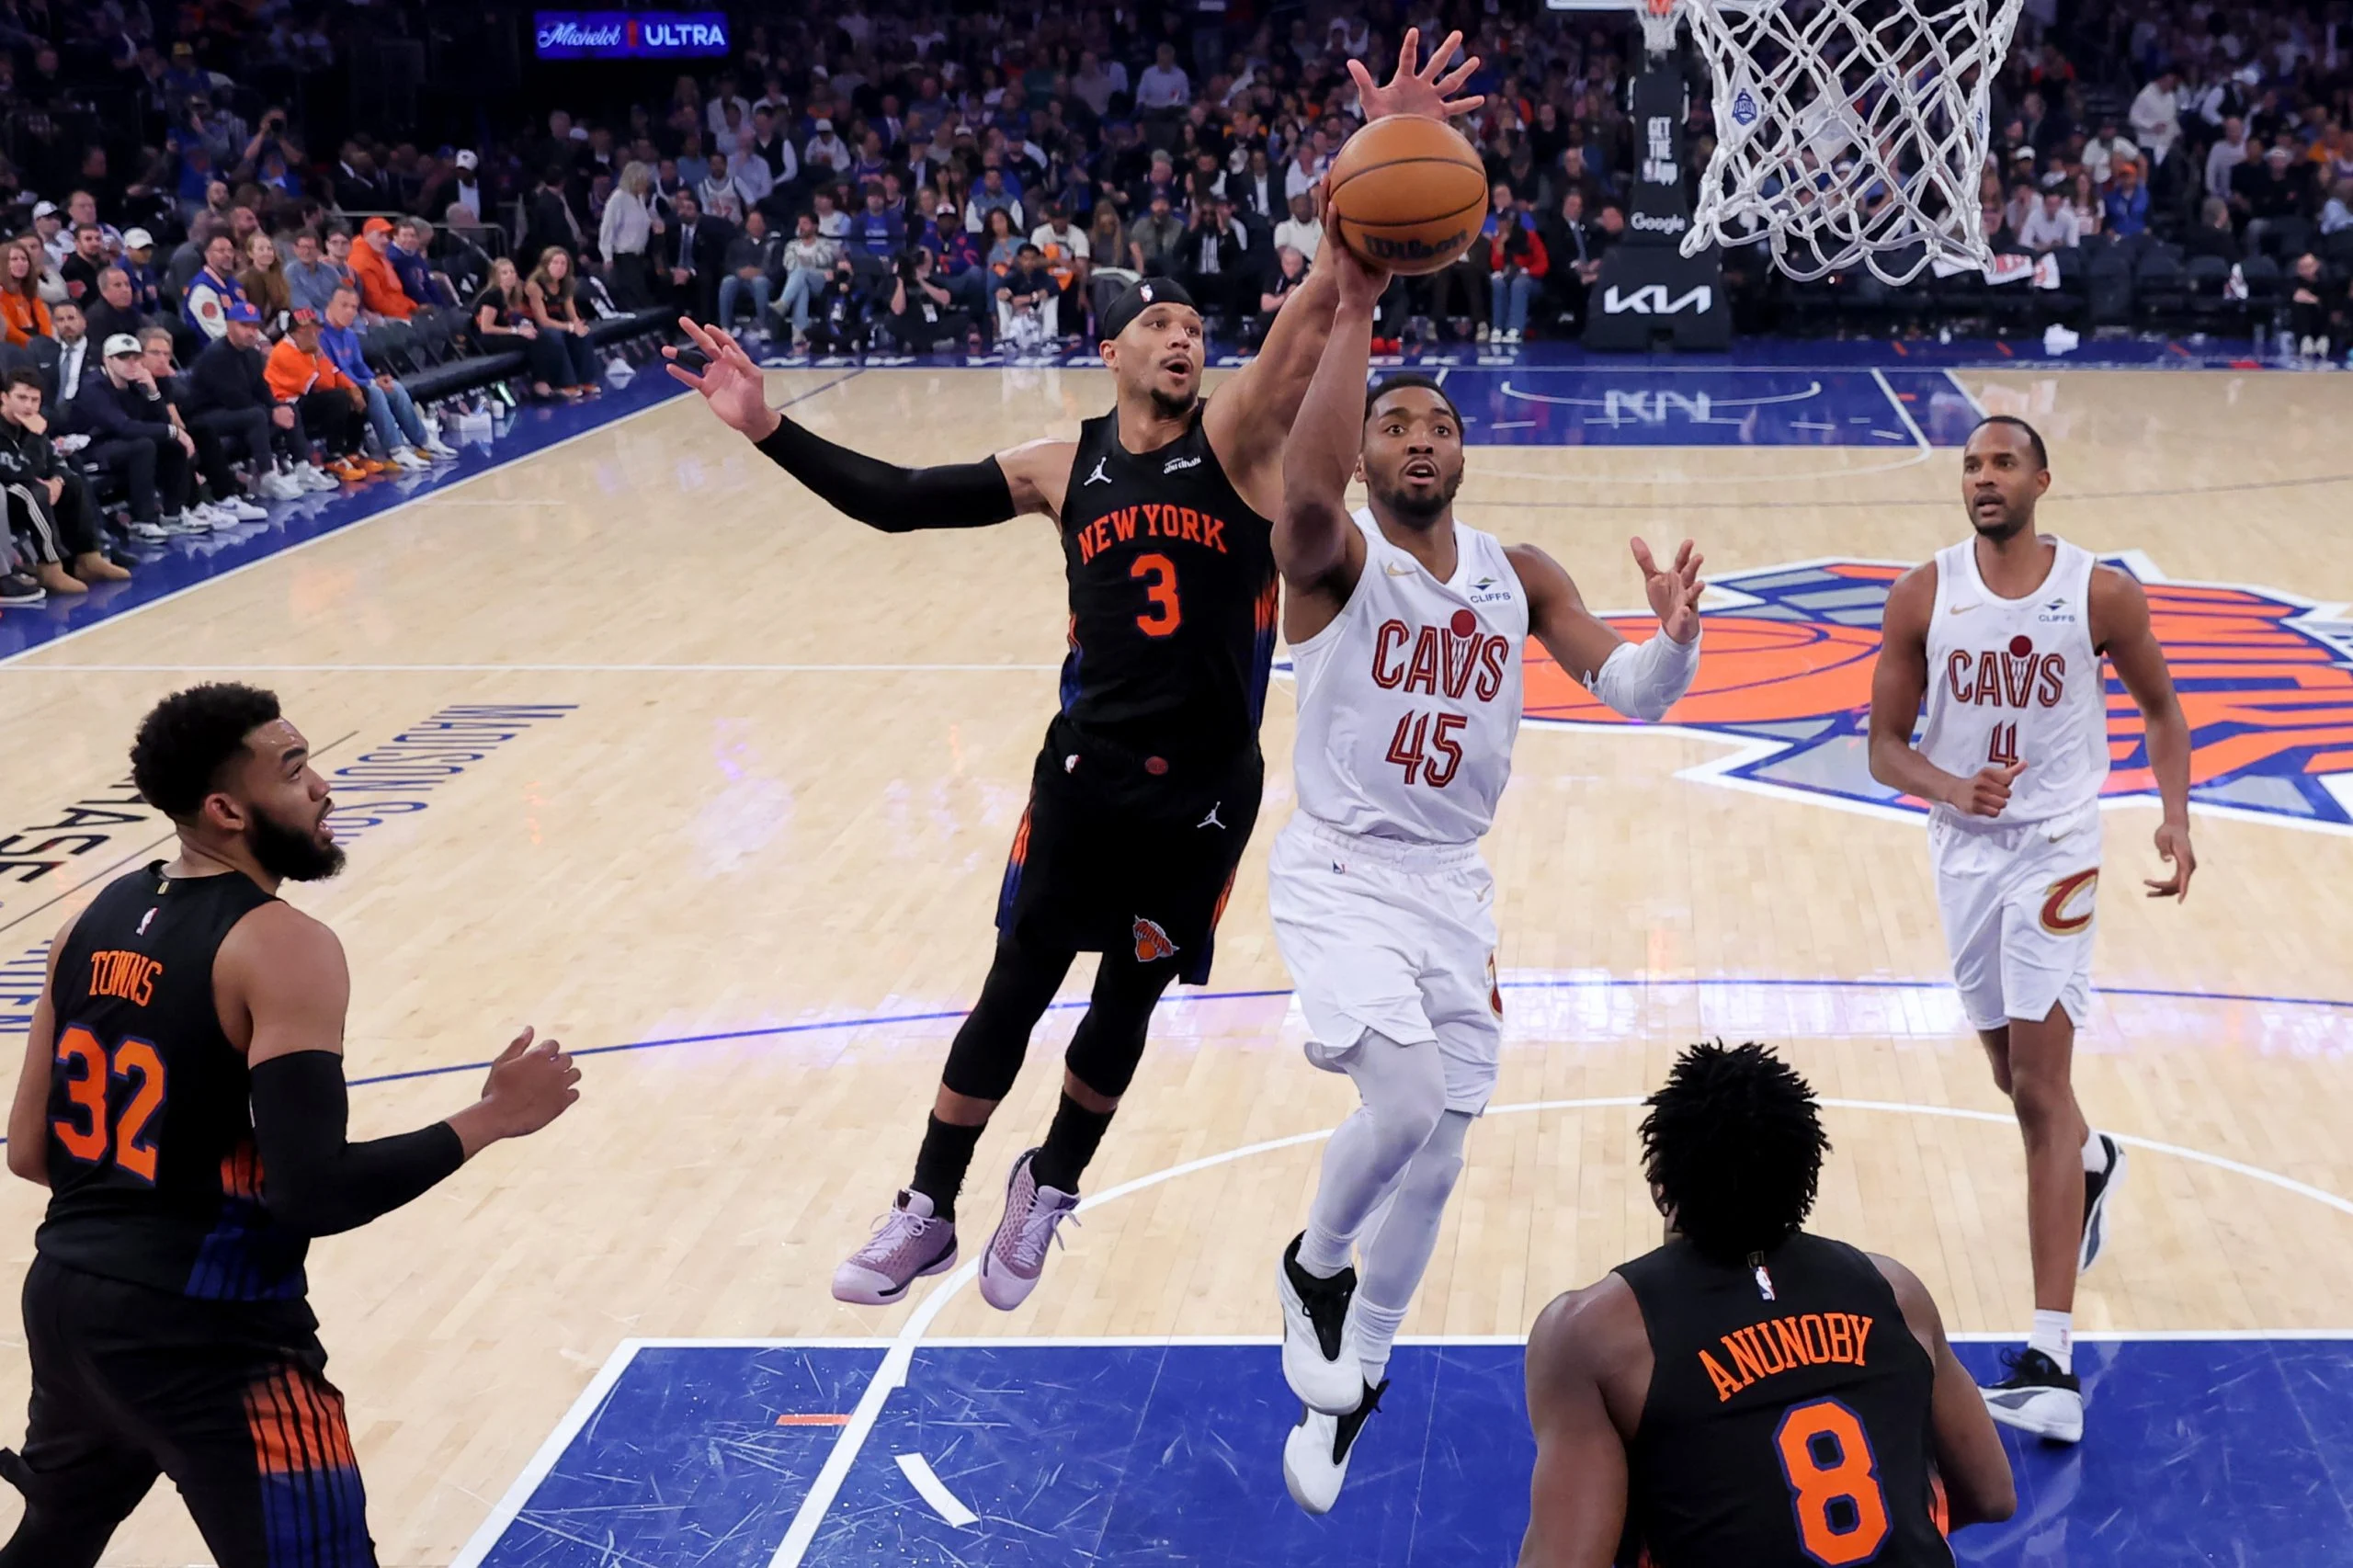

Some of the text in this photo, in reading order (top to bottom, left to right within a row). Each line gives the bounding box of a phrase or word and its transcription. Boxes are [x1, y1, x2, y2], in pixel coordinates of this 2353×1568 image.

[537, 21, 725, 48] Michelob ULTRA
[1362, 229, 1468, 261] Wilson
[1631, 211, 1686, 234] Google
[1604, 285, 1711, 314] KIA
[1077, 504, 1228, 566] NEW YORK
[1130, 553, 1183, 637] 3
[1471, 591, 1512, 603] CLIFFS
[2038, 614, 2075, 623] CLIFFS
[1371, 618, 1510, 702] CAVS
[1948, 649, 2066, 709] CAVS
[324, 704, 580, 791] MADISON
[1385, 710, 1468, 789] 45
[1988, 721, 2019, 769] 4
[88, 949, 163, 1007] TOWNS
[53, 1022, 167, 1184] 32
[1698, 1312, 1873, 1403] ANUNOBY
[1772, 1395, 1894, 1568] 8
